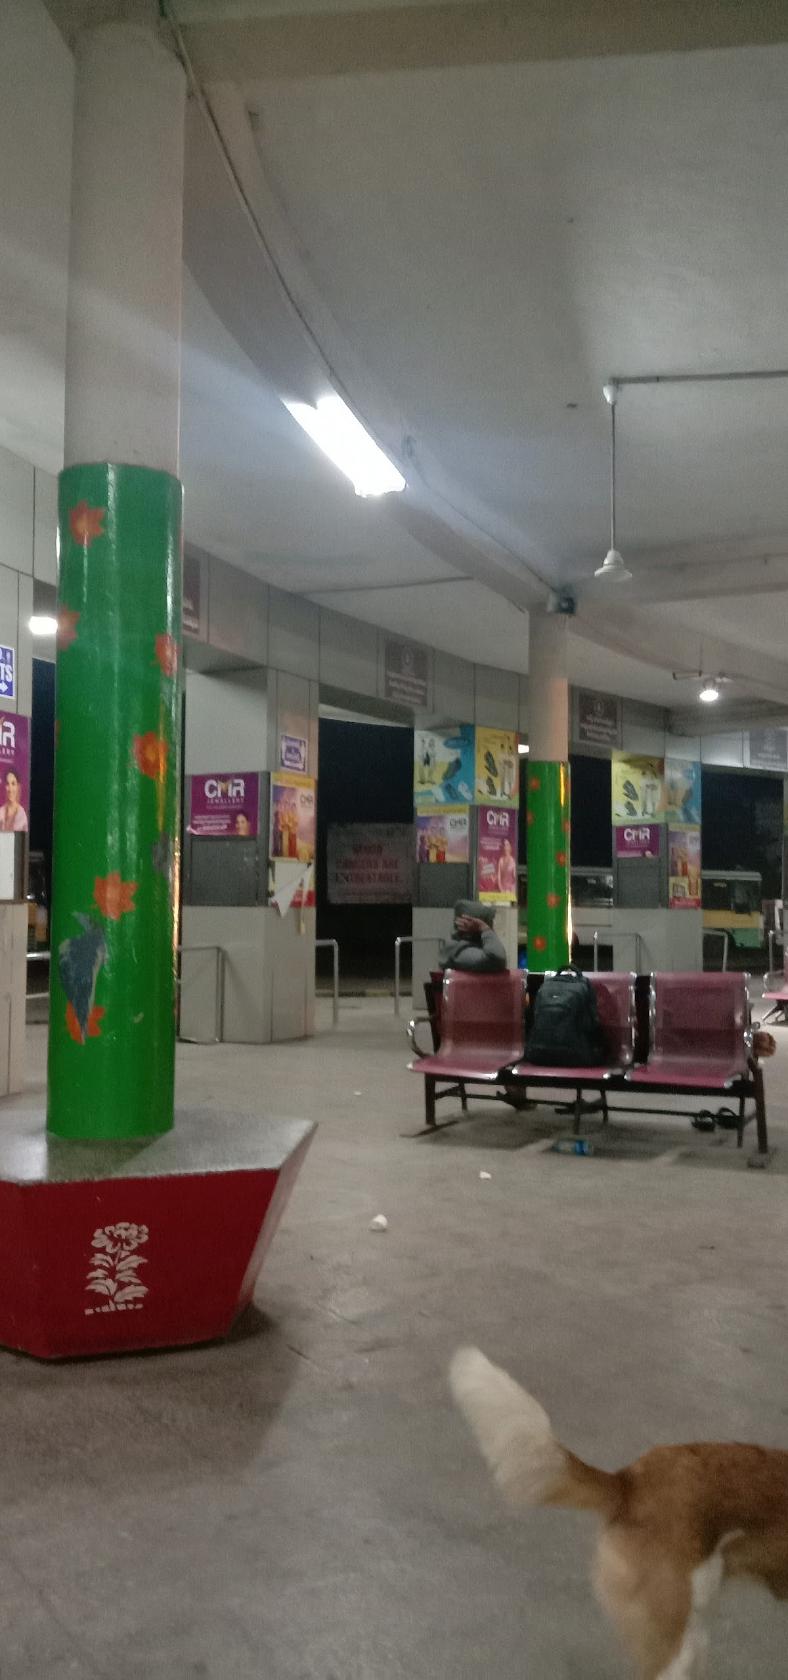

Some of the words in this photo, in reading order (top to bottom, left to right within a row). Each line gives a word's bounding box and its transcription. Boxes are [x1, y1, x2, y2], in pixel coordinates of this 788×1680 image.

[204, 779, 245, 798] CMR
[487, 810, 509, 827] CMR
[624, 828, 650, 841] CMR
